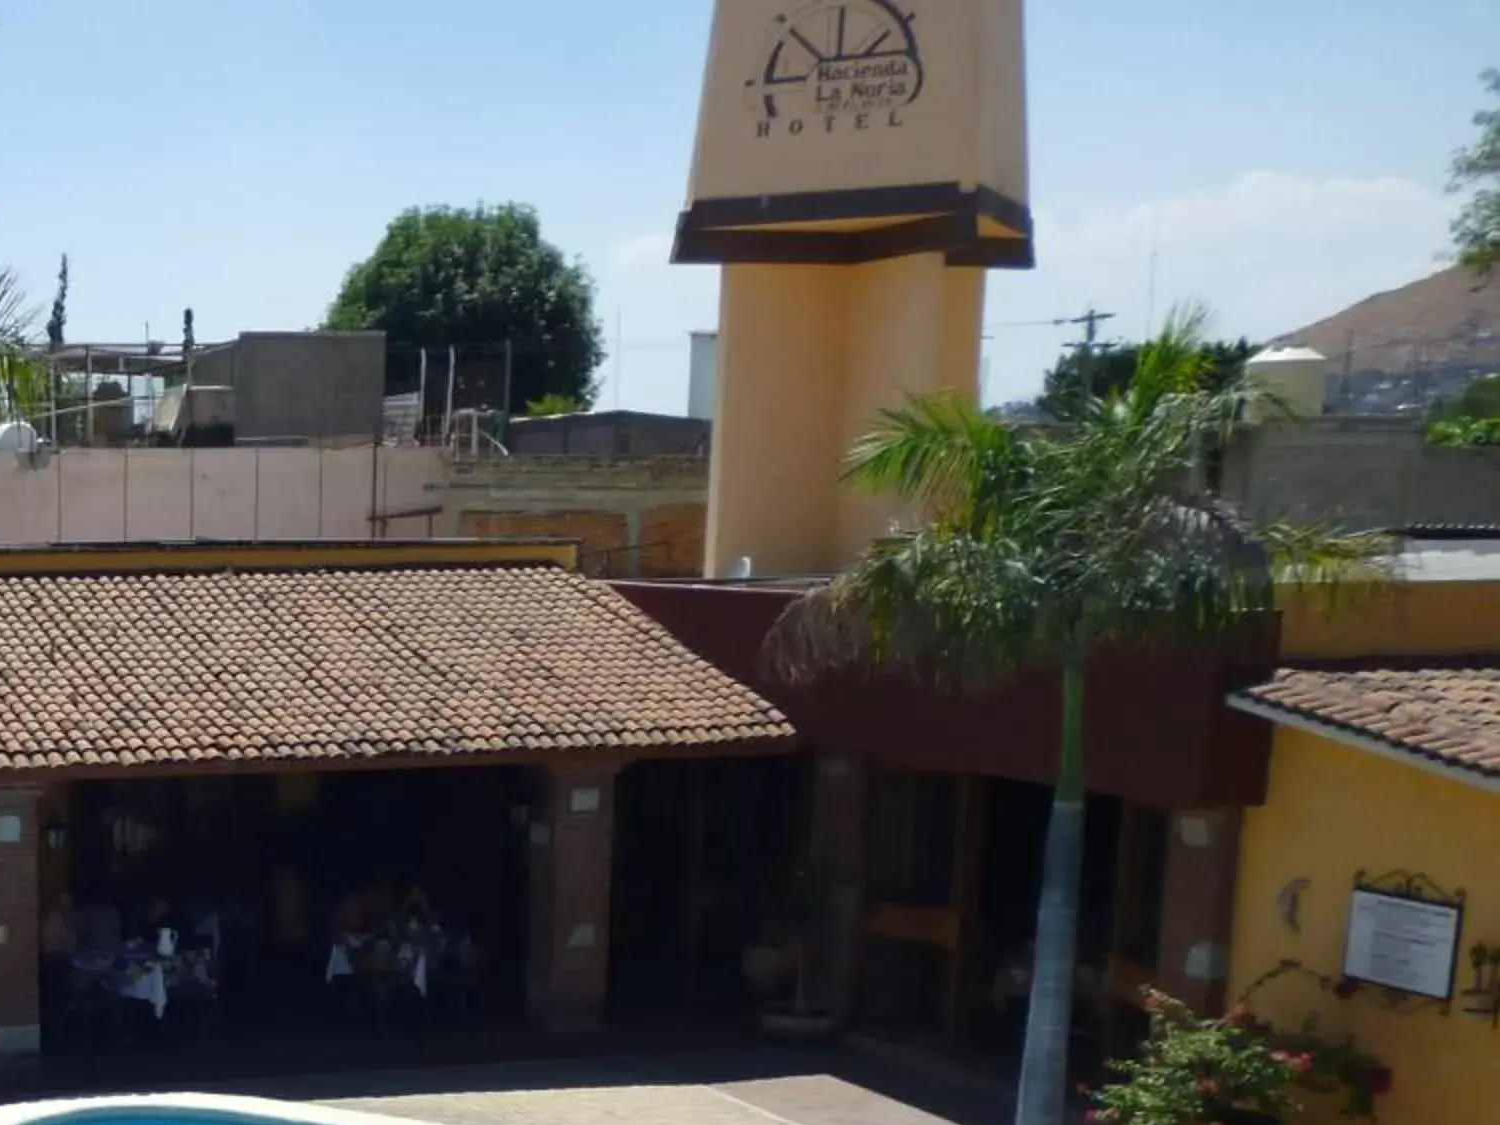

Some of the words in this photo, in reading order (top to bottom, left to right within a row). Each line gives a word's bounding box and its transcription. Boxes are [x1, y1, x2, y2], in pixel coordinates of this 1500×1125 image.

[818, 61, 907, 80] Hacienda
[816, 84, 841, 102] La
[756, 111, 902, 138] HOTEL
